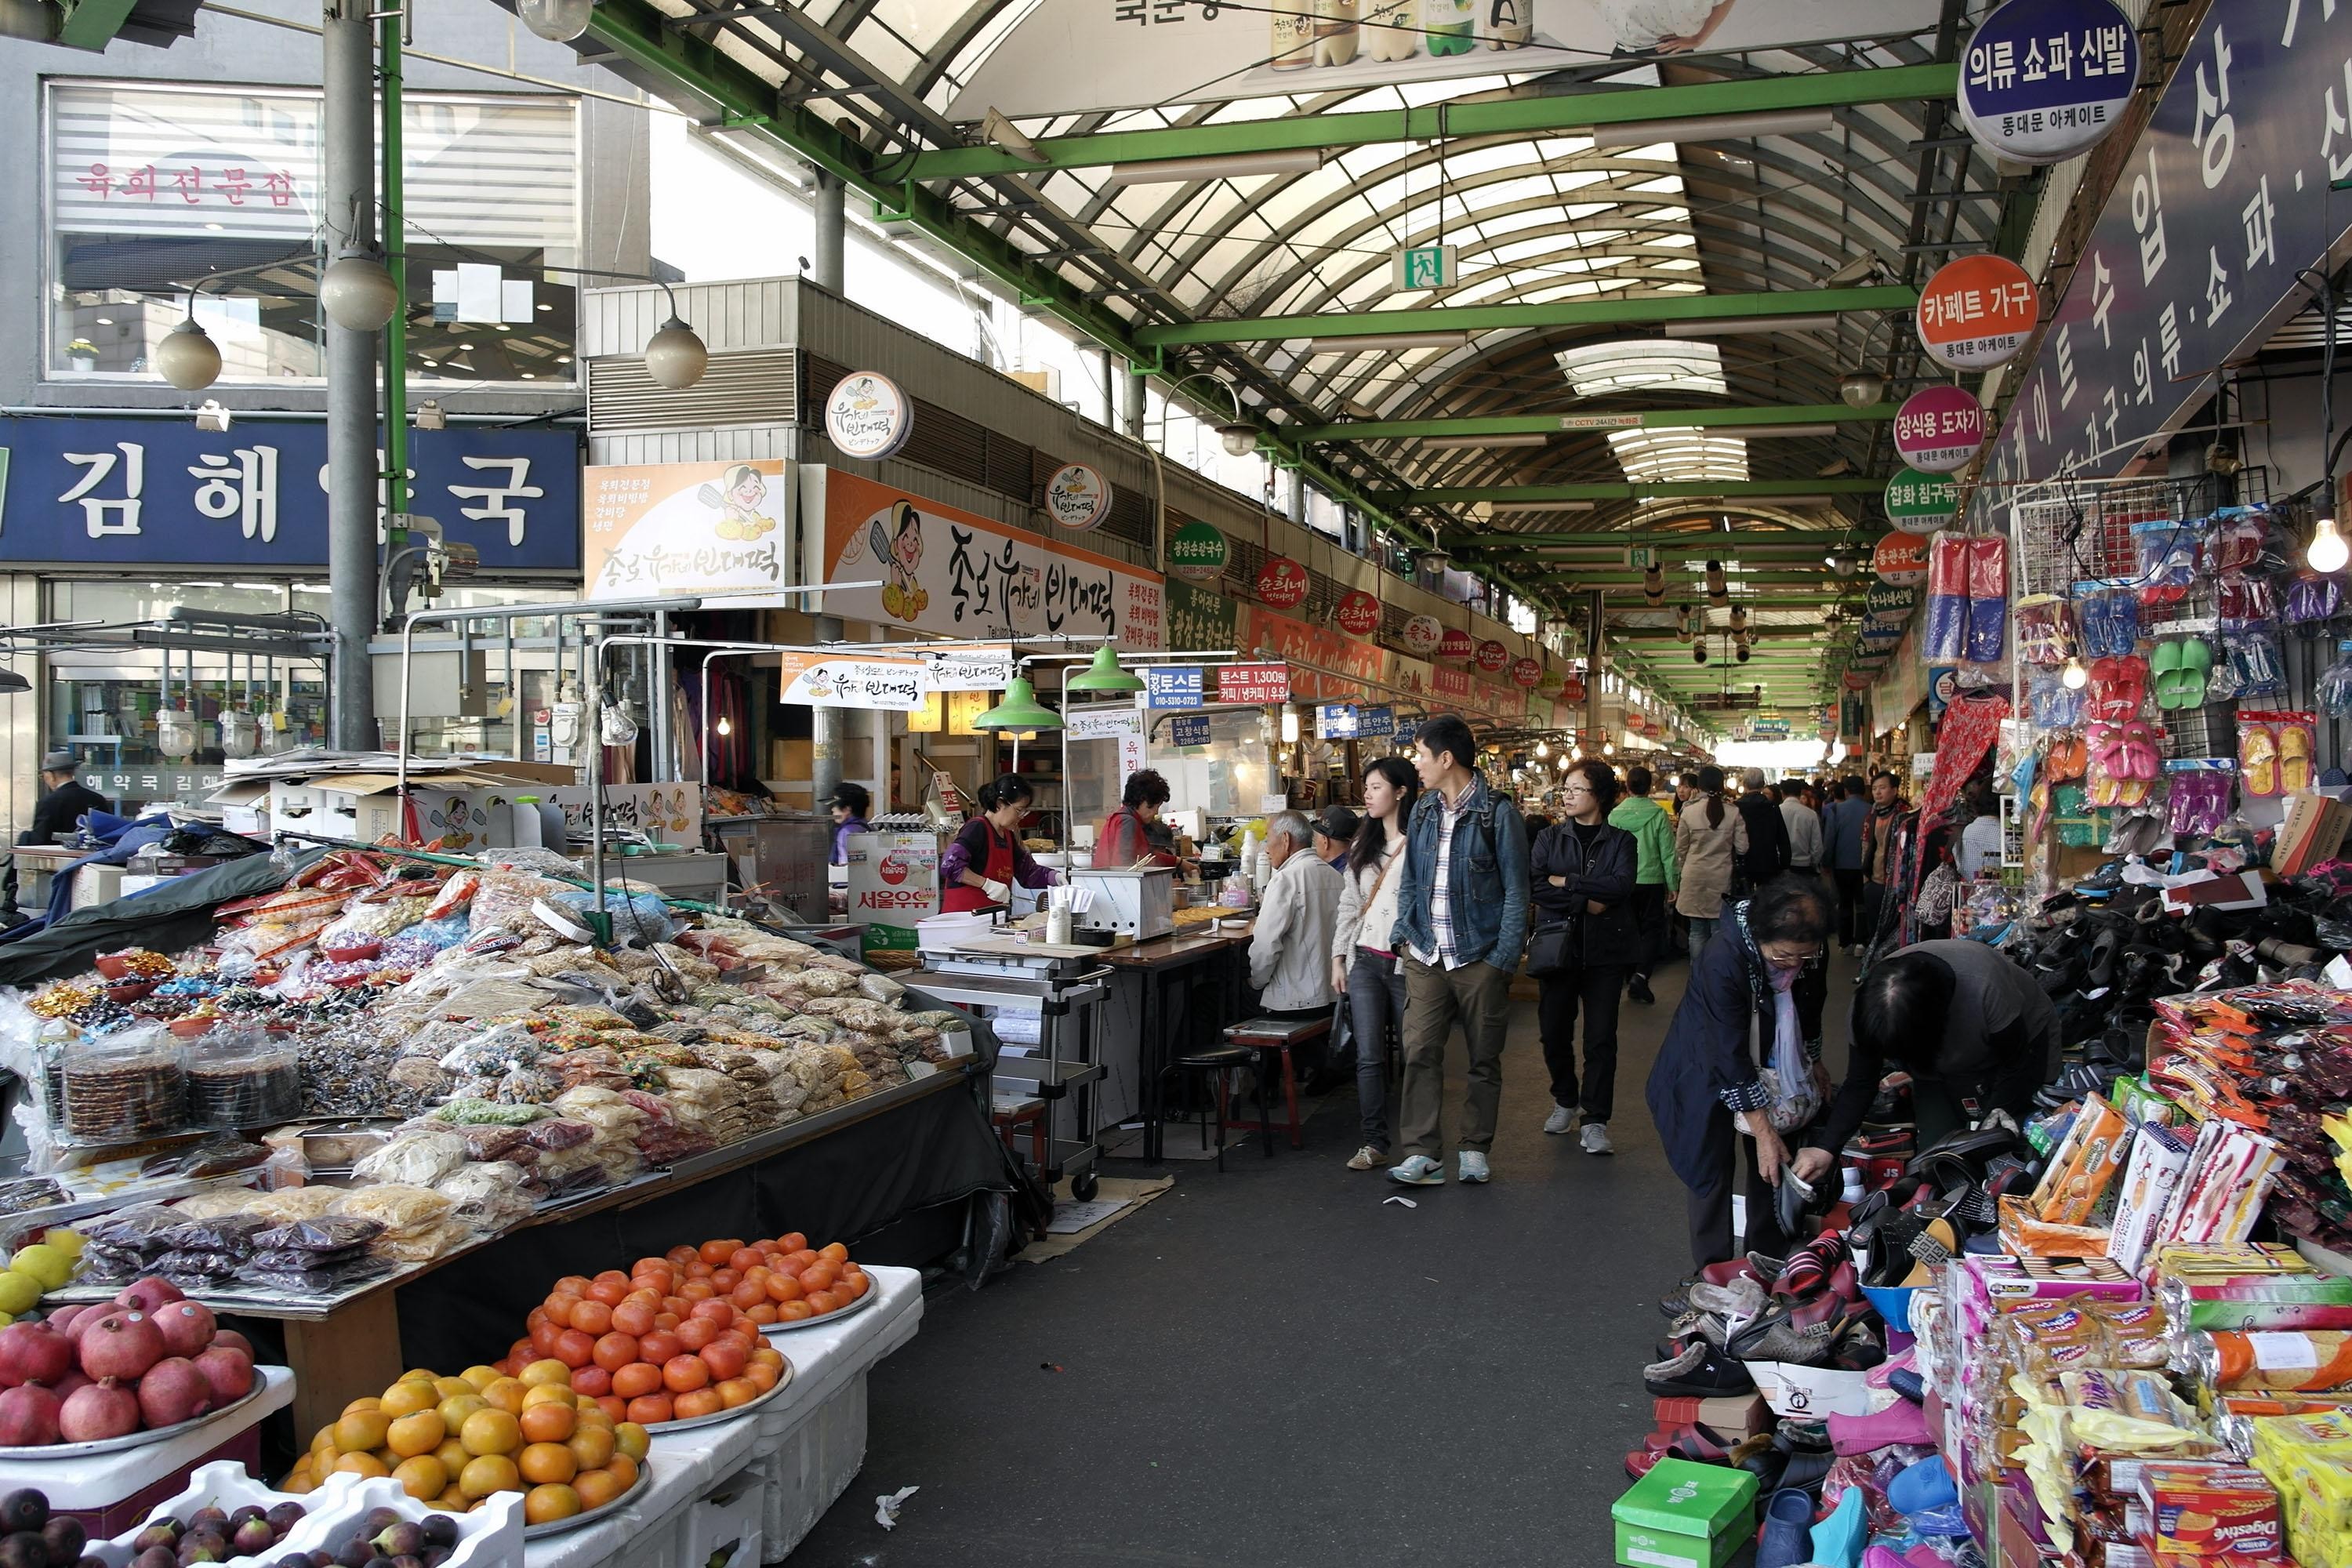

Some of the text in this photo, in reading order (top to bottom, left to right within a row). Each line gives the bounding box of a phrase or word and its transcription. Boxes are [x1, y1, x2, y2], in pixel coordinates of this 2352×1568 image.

[1969, 24, 2128, 92] 의류 쇼파 신발
[2002, 105, 2106, 137] 동대문 아케이트
[77, 162, 297, 206] 육회전문점
[1924, 281, 2031, 328] 카페트 가구
[1946, 336, 2016, 358] 동대문 아케이트
[847, 418, 891, 436] 빈대떡
[1898, 406, 1980, 441] 장식용 도자기
[1916, 447, 1969, 463] 동대문 아케이트
[598, 477, 651, 491] 육회전문점
[58, 441, 545, 546] 김해국
[1890, 483, 1958, 506] 잡화 침구류
[596, 506, 626, 519] 갈비탕
[1061, 500, 1094, 514] 빈대떡
[593, 520, 614, 532] 냉면
[1902, 515, 1919, 528] 동대문
[1174, 540, 1223, 558] 광장손칼국수
[603, 546, 643, 587] 종로
[694, 541, 779, 582] 빈대떡
[1258, 576, 1305, 593] 순희네
[1045, 563, 1115, 642] 빈대떡
[1190, 588, 1221, 615] 홍어전문
[1266, 593, 1294, 602] 빈대떡
[1338, 606, 1379, 620] 순희네
[1174, 609, 1231, 659] 광장손칼국수
[959, 663, 1007, 681] 빈대떡
[1221, 671, 1286, 684] 토스트 1,300원
[866, 680, 918, 702] 빈대떡
[1150, 673, 1160, 695] 광장
[1160, 675, 1201, 693] 토스트
[1155, 697, 1198, 706] 010-5310-0723
[1176, 725, 1209, 736] 고창식품
[858, 891, 929, 909] 서울우유
[1883, 1168, 1899, 1178] JS
[2213, 1519, 2278, 1539] Digestive
